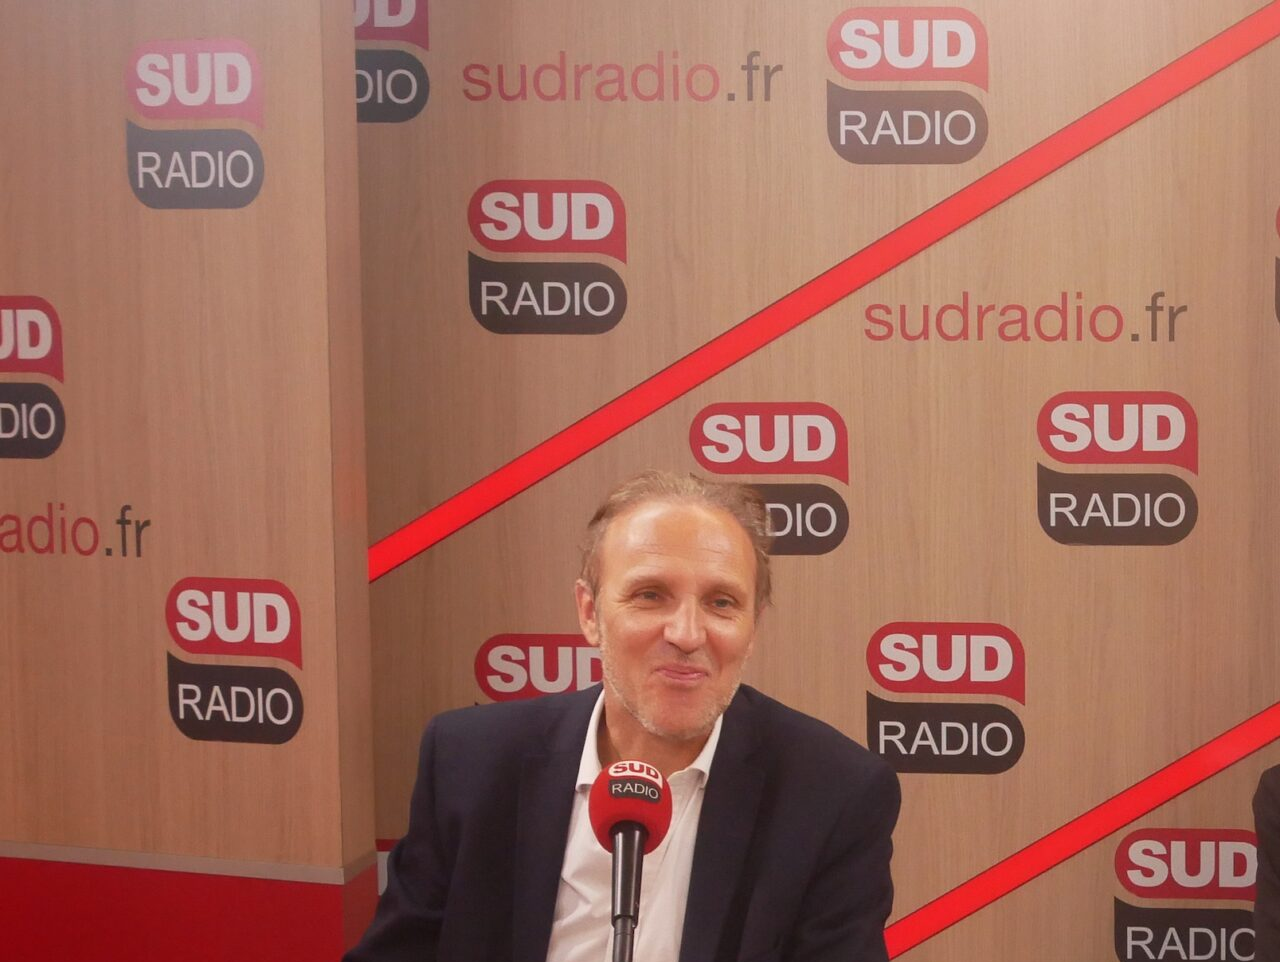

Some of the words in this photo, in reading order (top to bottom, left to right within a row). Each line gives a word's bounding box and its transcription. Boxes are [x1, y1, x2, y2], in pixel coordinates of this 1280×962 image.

[839, 20, 976, 69] SUD
[136, 52, 252, 107] SUD
[356, 69, 417, 104] DIO
[463, 51, 782, 102] sudradio.fr
[840, 110, 976, 146] RADIO
[137, 151, 254, 188] RADIO
[480, 192, 613, 240] SUD
[481, 281, 615, 316] RADIO
[864, 291, 1187, 342] sudradio.fr
[0, 403, 55, 439] DIO
[701, 415, 836, 463] SUD
[1049, 403, 1186, 453] SUD
[0, 503, 151, 557] adio.fr
[765, 503, 837, 537] DIO
[1049, 492, 1186, 527] RADIO
[176, 589, 291, 644] SUD
[878, 633, 1013, 682] SUD
[178, 684, 293, 726] RADIO
[878, 720, 1013, 756] RADIO
[612, 783, 658, 799] RADIO
[613, 763, 658, 779] SUD
[1127, 840, 1258, 888] SUD
